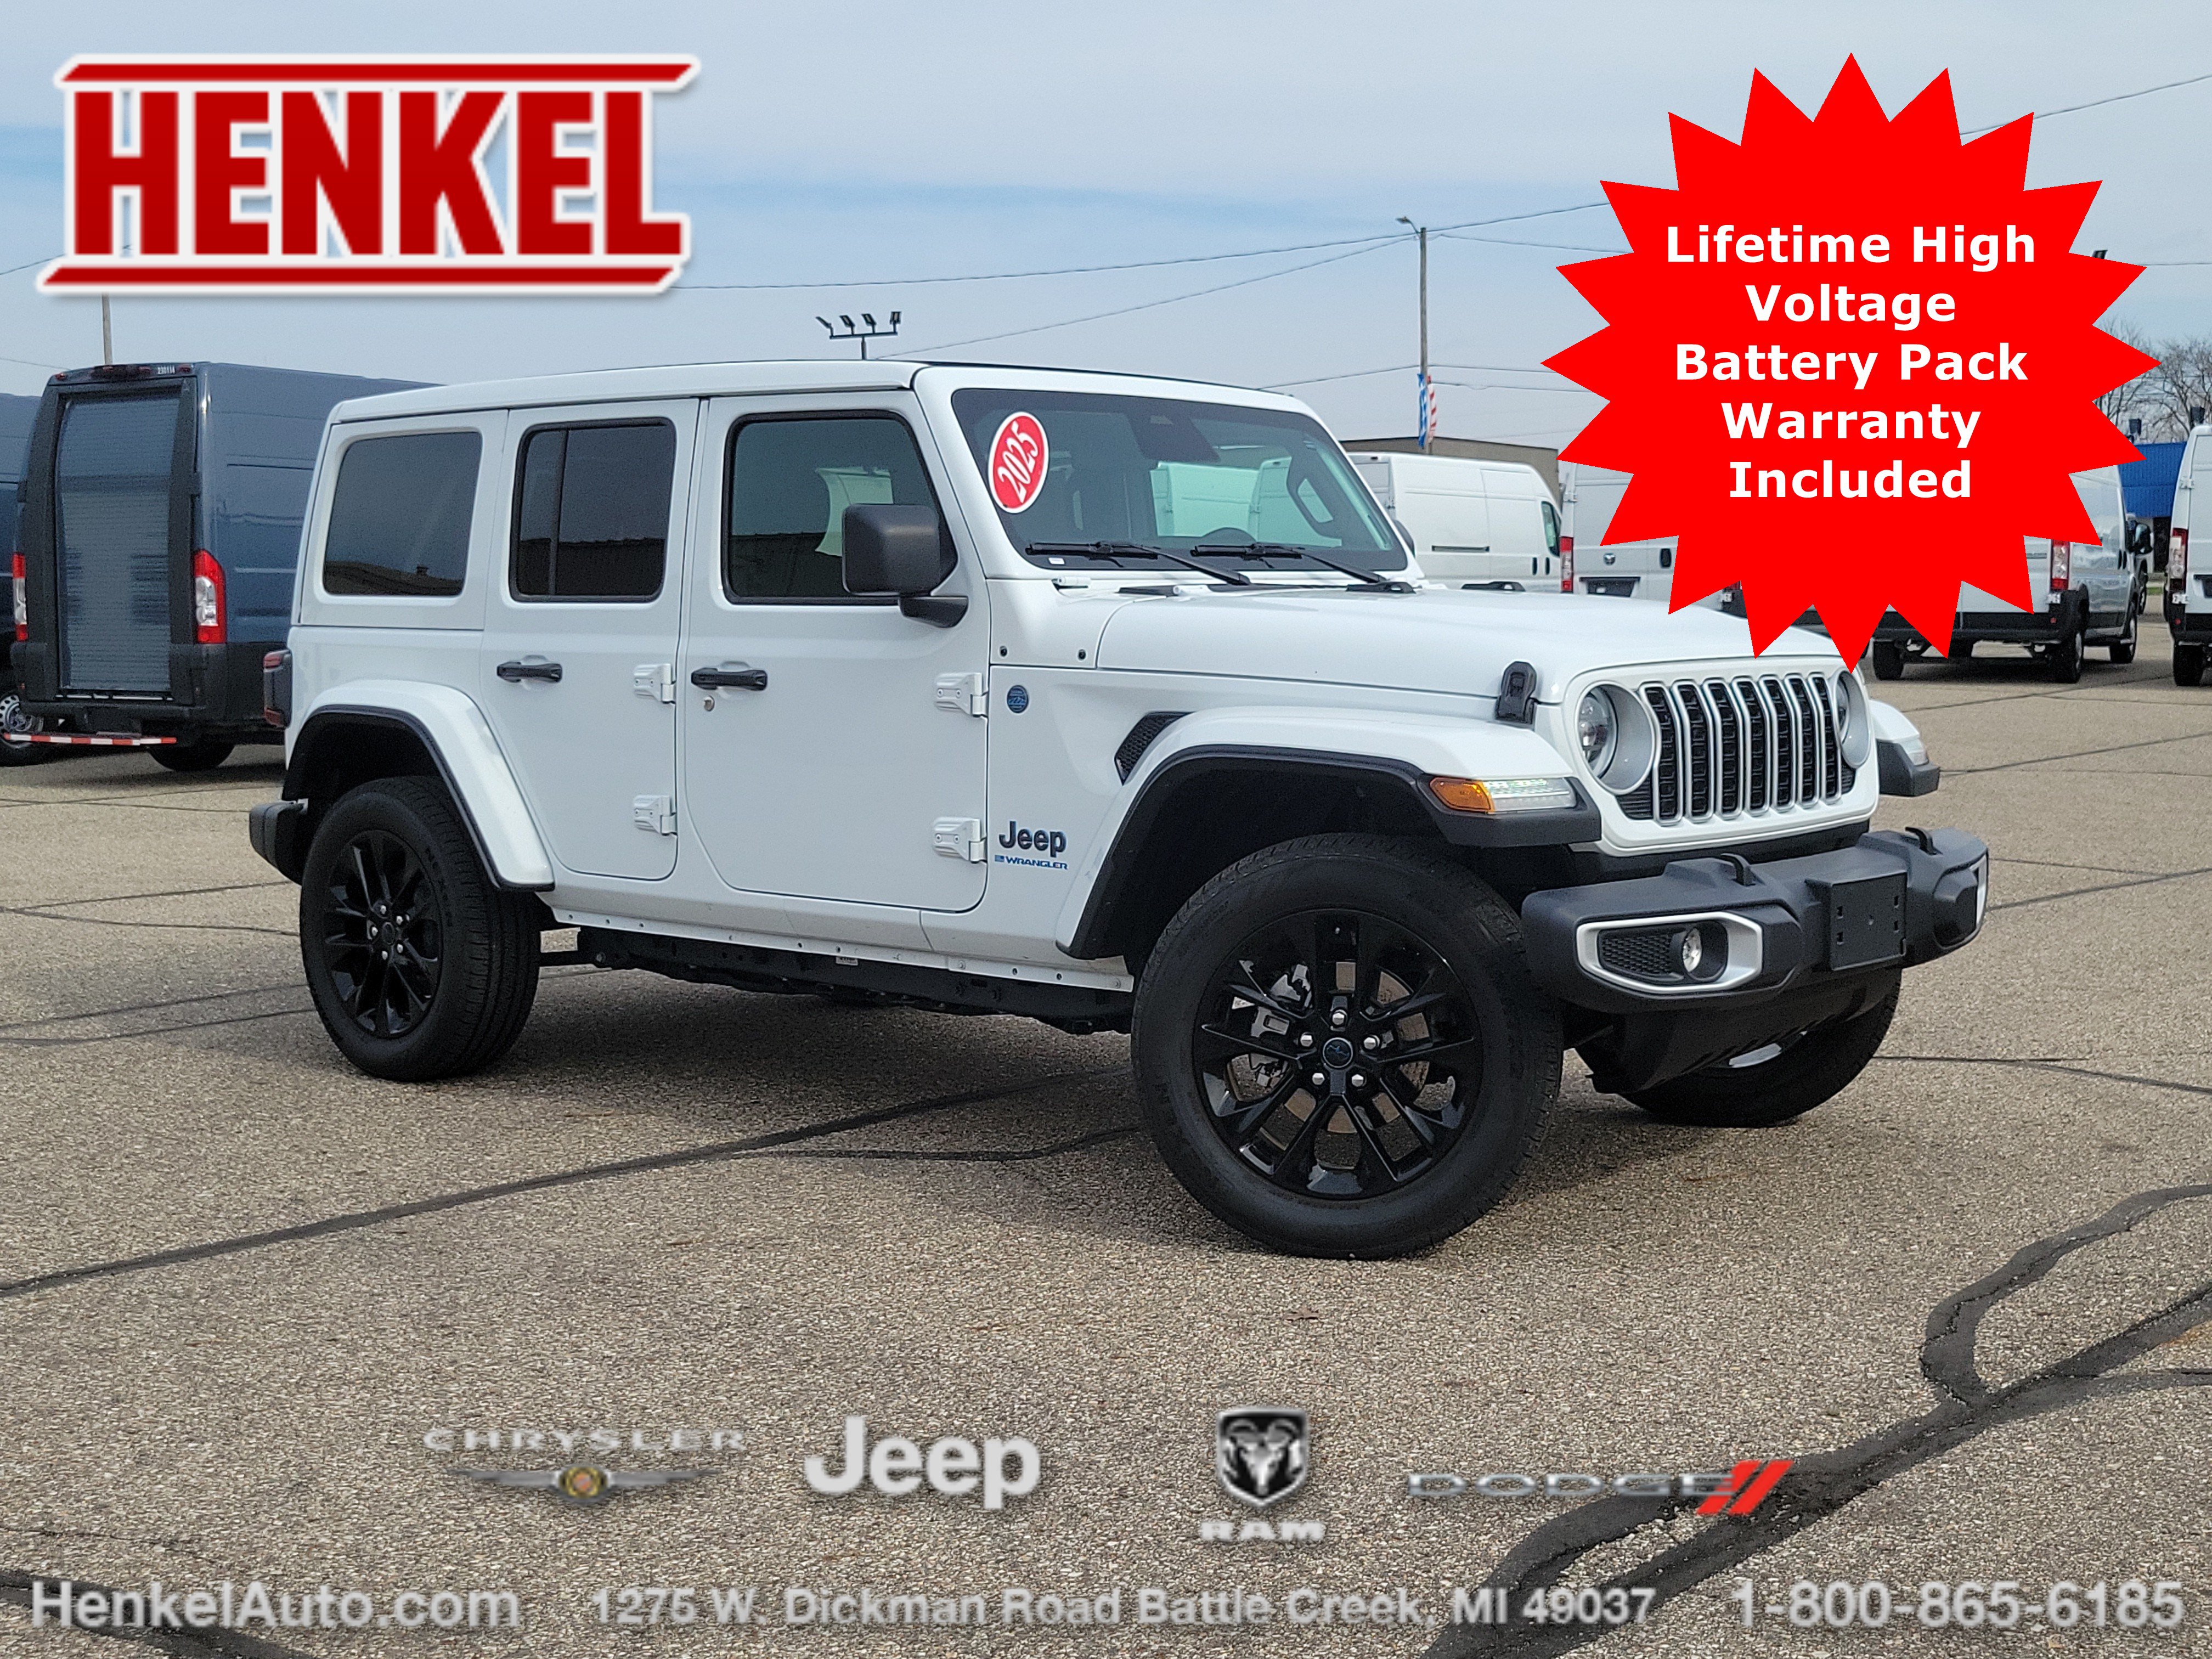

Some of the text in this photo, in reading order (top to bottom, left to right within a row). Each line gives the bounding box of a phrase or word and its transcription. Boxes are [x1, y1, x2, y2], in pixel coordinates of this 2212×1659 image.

[997, 420, 1038, 504] 2025
[998, 820, 1066, 857] Jeep
[1005, 855, 1068, 870] WRANGLER
